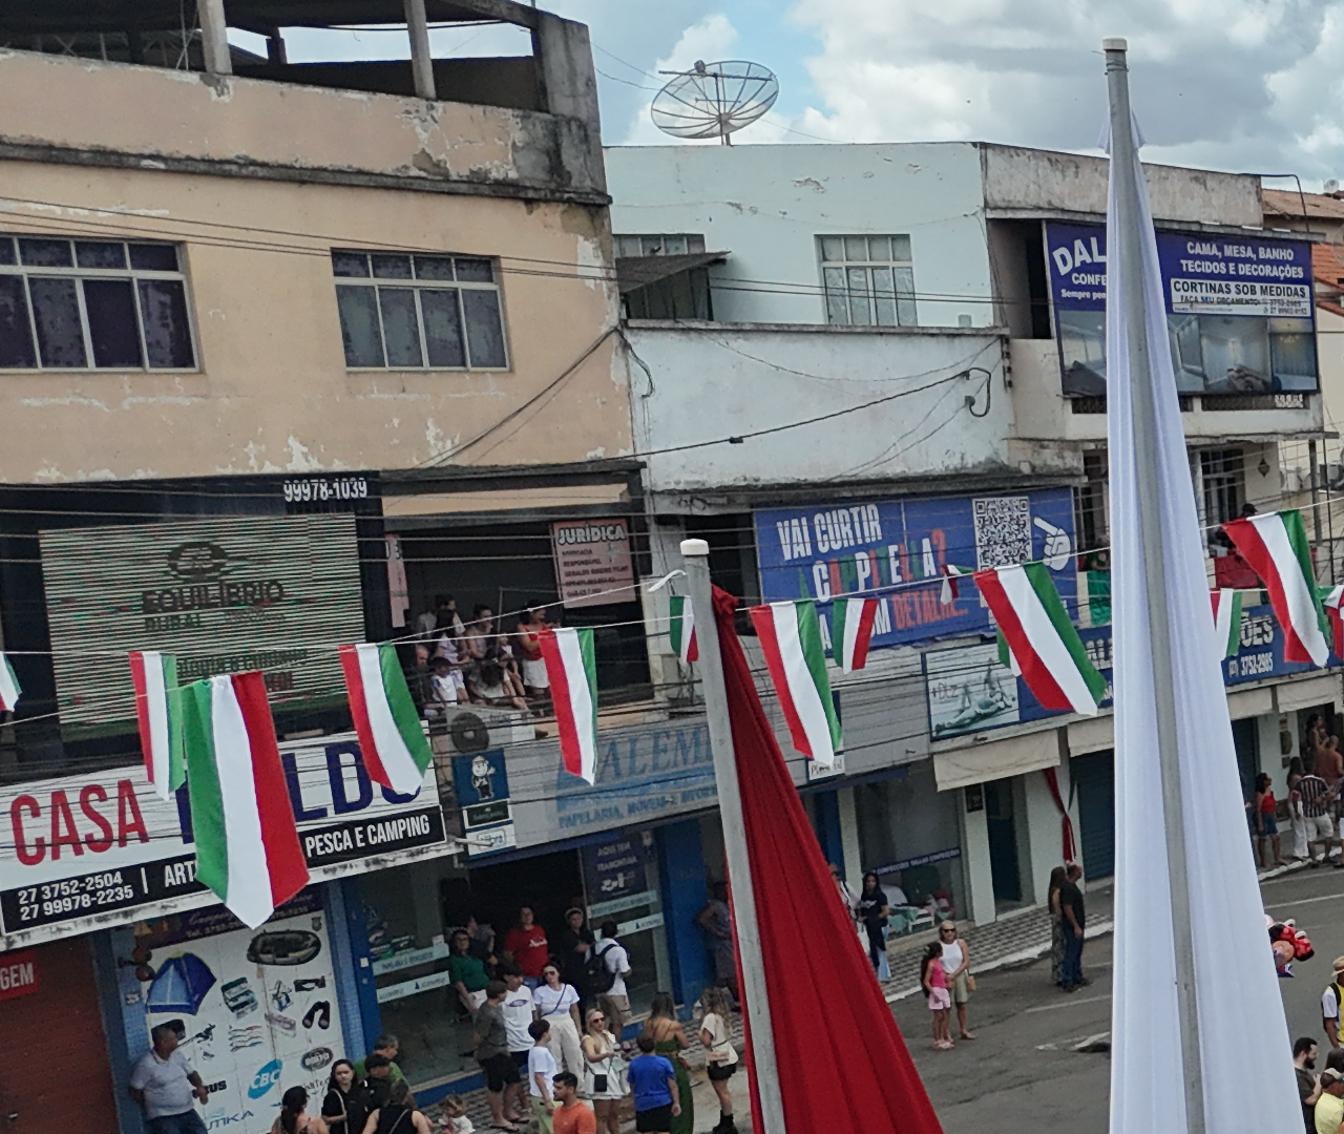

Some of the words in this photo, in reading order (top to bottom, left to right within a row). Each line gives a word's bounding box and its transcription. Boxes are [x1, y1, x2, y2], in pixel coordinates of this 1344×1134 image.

[1052, 236, 1107, 276] DAL
[1186, 240, 1222, 259] CAMA,
[1223, 243, 1256, 261] MESA,
[1258, 246, 1294, 261] BANHO
[1071, 272, 1107, 287] CONFE
[1180, 259, 1227, 275] TECIDOS
[1228, 263, 1236, 274] E
[1238, 261, 1304, 280] DECORAÇÕES
[1173, 280, 1232, 295] CORTINAS
[1234, 283, 1258, 296] SOB
[1260, 284, 1306, 298] MEDIDAS
[283, 477, 368, 502] 99978-1039
[558, 524, 626, 545] JURÍDICA
[776, 516, 813, 561] VAI
[813, 503, 883, 554] CURTIR
[601, 724, 713, 780] ALEM
[11, 778, 150, 866] CASA
[305, 833, 353, 858] PESCA
[355, 827, 365, 848] E
[367, 814, 430, 845] CAMPING
[18, 888, 37, 905] 27
[41, 871, 123, 899] 3752-2504
[164, 860, 196, 888] ART
[20, 903, 40, 921] 27
[43, 885, 134, 916] 99978-2235
[0, 961, 35, 990] GEM
[251, 1068, 281, 1089] CBC
